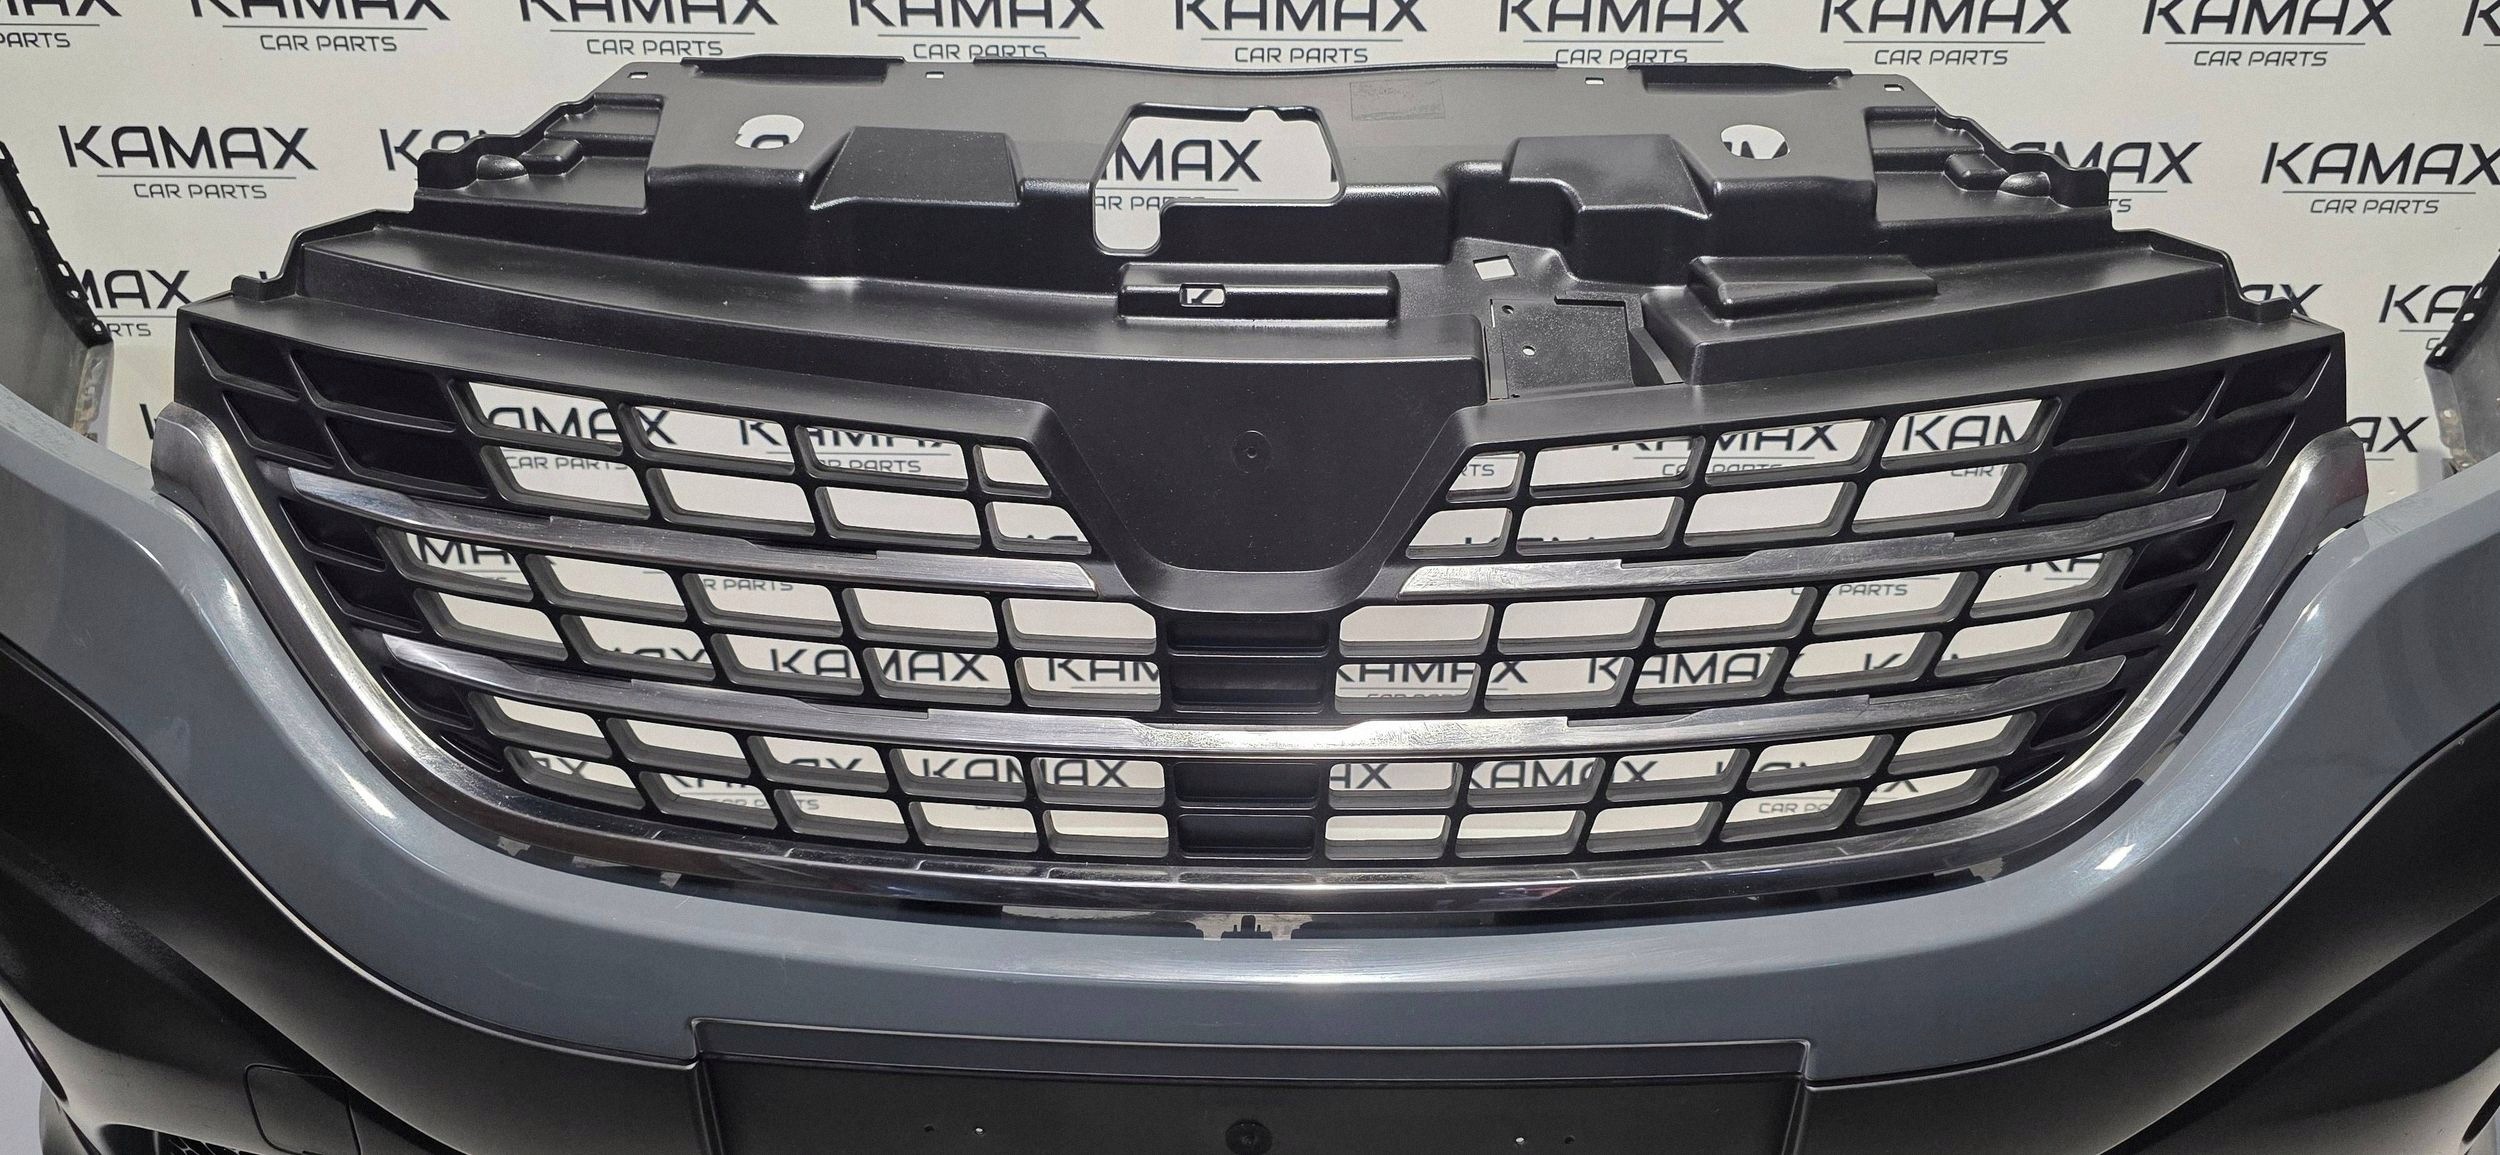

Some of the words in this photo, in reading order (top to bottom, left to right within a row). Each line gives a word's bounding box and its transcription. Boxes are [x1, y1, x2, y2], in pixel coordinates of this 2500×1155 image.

[1498, 0, 1750, 33] KAMAX
[1819, 0, 2071, 34] KAMAX
[2141, 0, 2392, 36] KAMAX
[260, 34, 310, 51] CAR
[316, 35, 398, 52] PARTS
[586, 38, 634, 55] CAR
[642, 40, 724, 56] PARTS
[913, 43, 960, 60] CAR
[968, 44, 1048, 59] PARTS
[1234, 47, 1281, 63] CAR
[1290, 47, 1369, 64] PARTS
[1555, 49, 1602, 64] CAR
[1609, 49, 1688, 65] PARTS
[1874, 49, 1922, 65] CAR
[1928, 49, 2009, 66] PARTS
[2193, 50, 2241, 67] CAR
[2247, 50, 2328, 67] PARTS
[58, 125, 319, 171] KAMAX
[1101, 138, 1263, 182] MAX
[2260, 142, 2500, 185] KAMAX
[134, 183, 182, 199] CAR
[188, 183, 268, 199] PARTS
[1095, 196, 1122, 211] AR
[2310, 199, 2355, 214] CAR
[2362, 199, 2440, 214] PARTS
[107, 323, 152, 336] RTS
[487, 406, 678, 446] AMAX
[1839, 584, 1908, 597] PARTS
[1759, 803, 1797, 815] CAR
